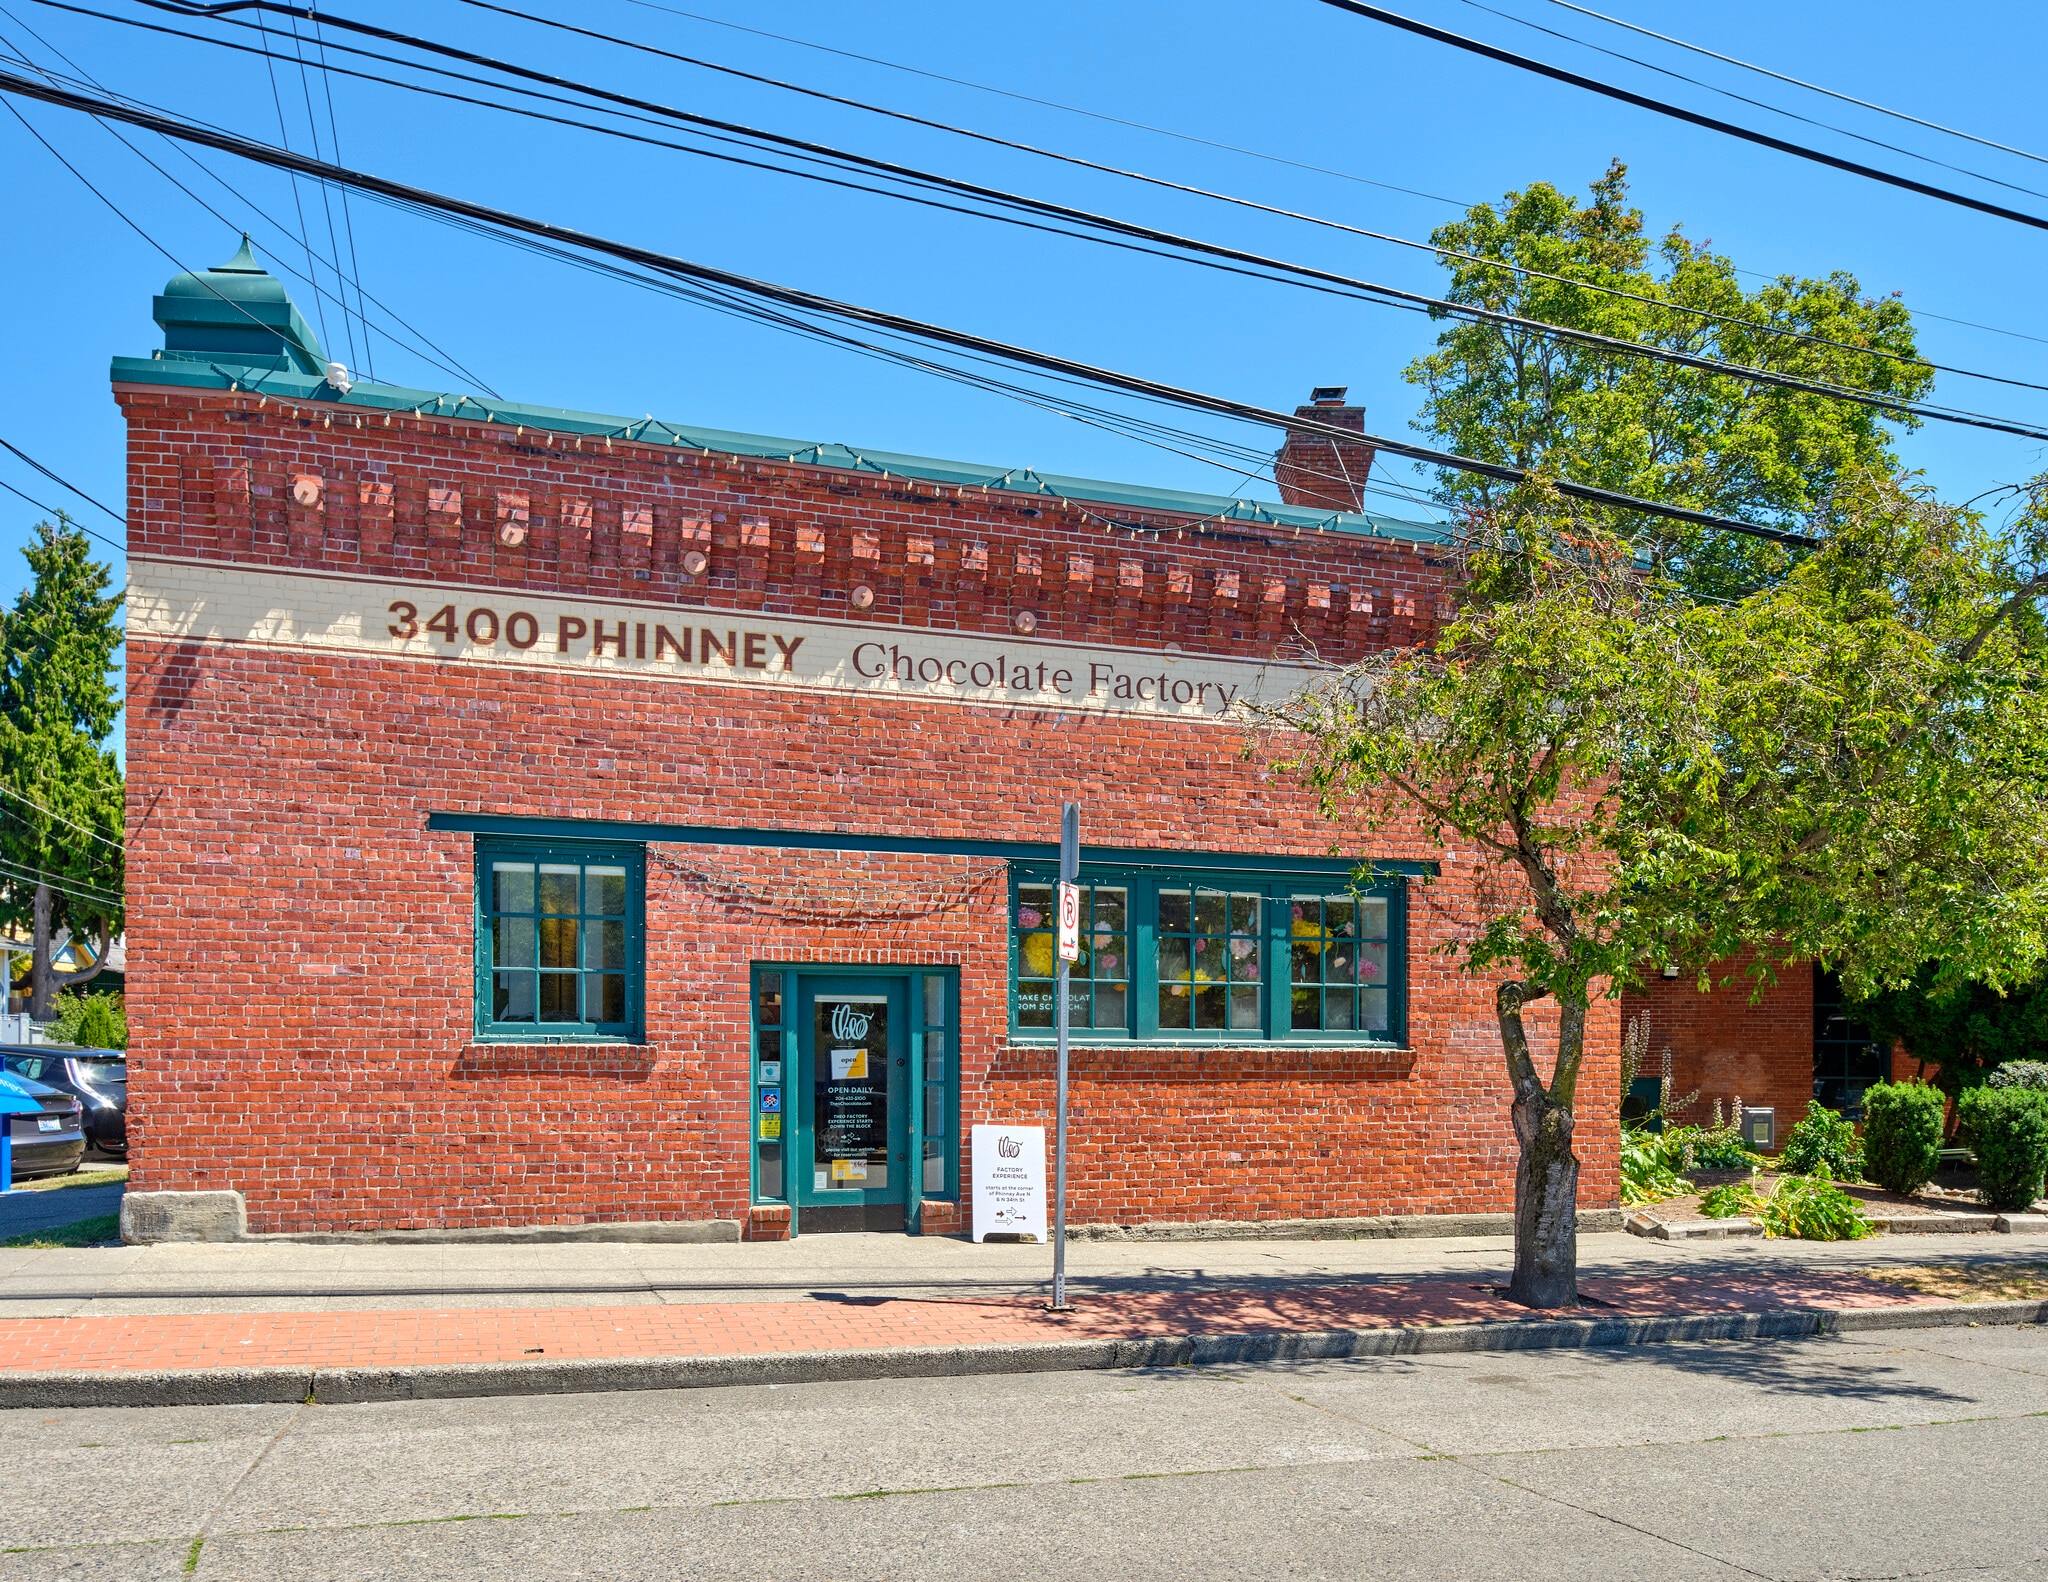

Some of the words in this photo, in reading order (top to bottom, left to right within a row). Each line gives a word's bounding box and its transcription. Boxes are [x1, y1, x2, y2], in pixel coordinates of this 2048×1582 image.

[387, 600, 540, 650] 3400
[557, 614, 806, 673] PHINNEY
[852, 642, 1074, 694] Chocolate
[1087, 662, 1239, 721] Factory
[827, 1086, 849, 1094] OPEN
[851, 1086, 874, 1094] DAILY
